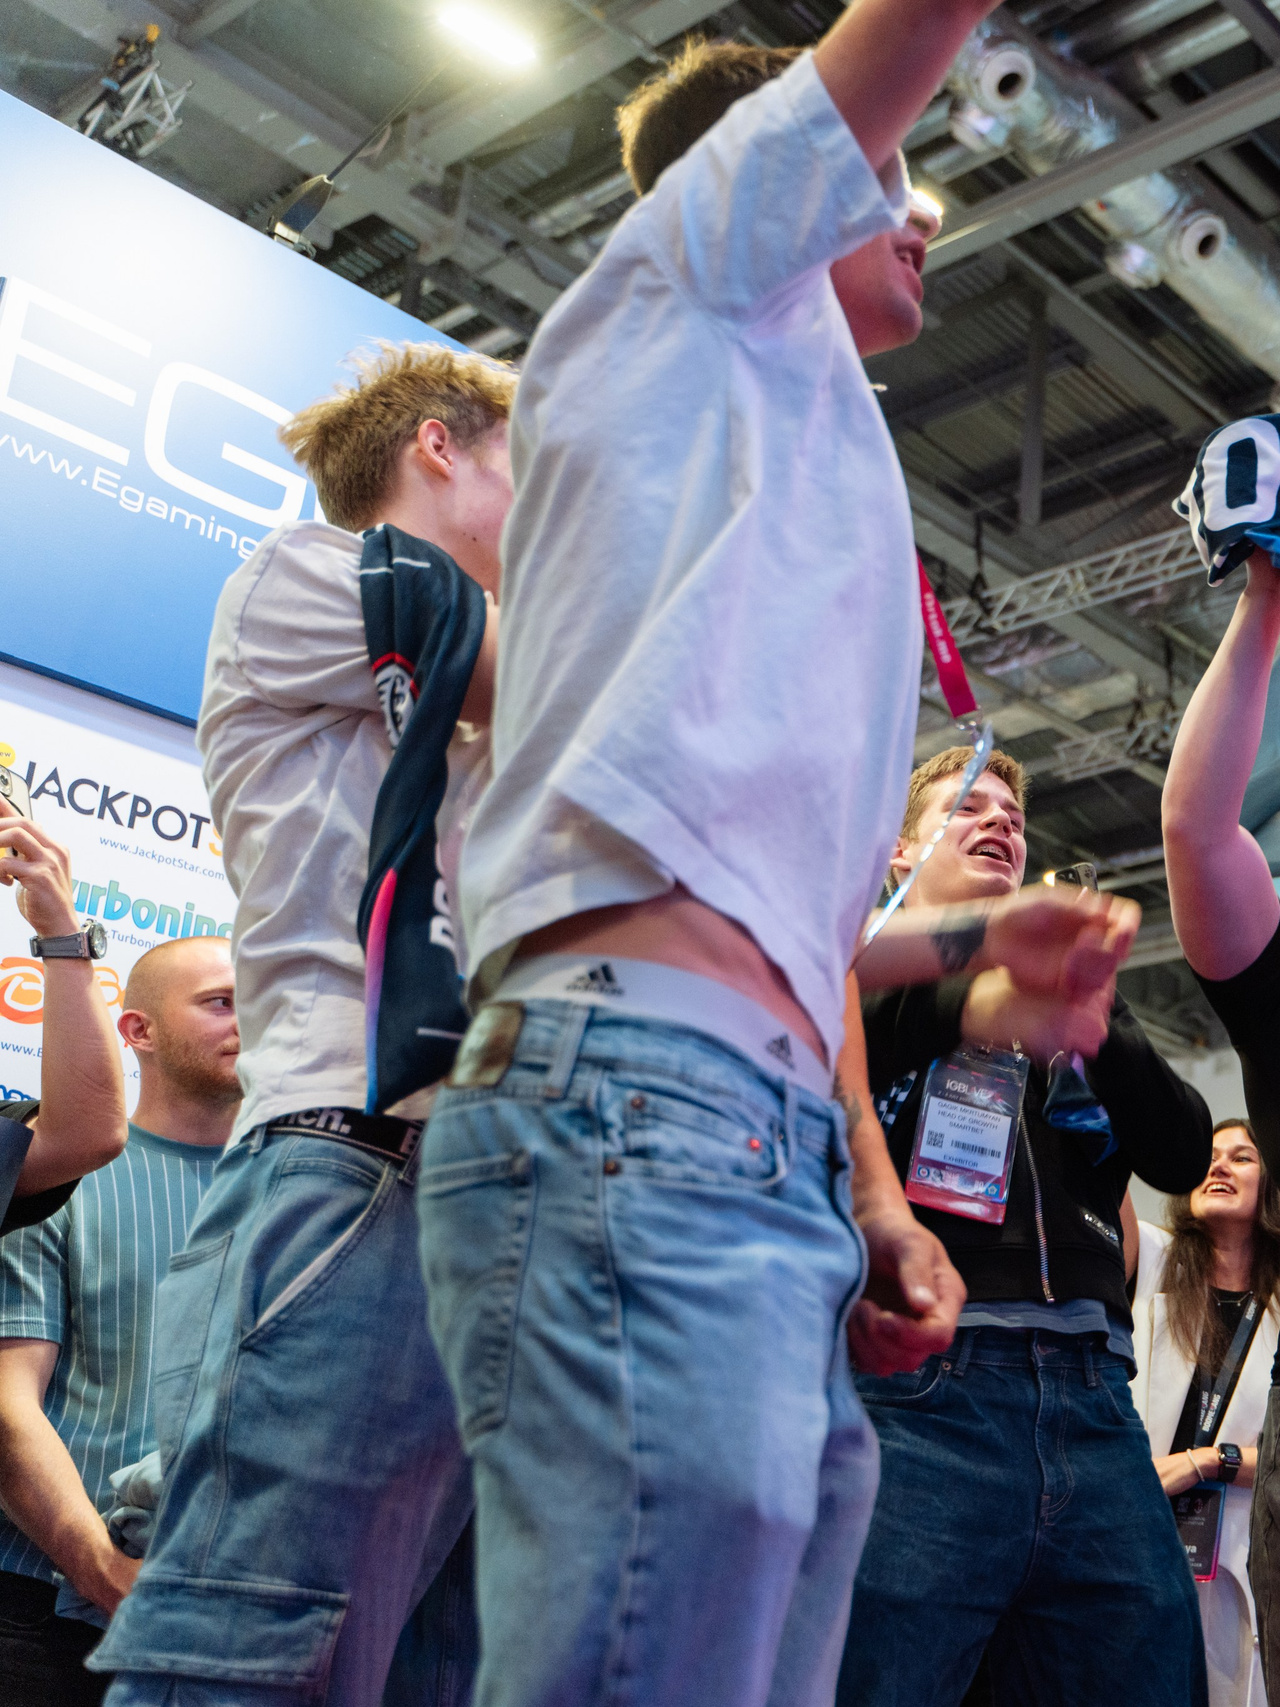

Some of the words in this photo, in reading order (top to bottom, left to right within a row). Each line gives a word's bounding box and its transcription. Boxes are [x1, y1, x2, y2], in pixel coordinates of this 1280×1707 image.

[0, 276, 327, 529] EG
[0, 434, 260, 561] ww.Egaming
[99, 836, 226, 881] www.JackpotStar.com
[942, 1153, 978, 1168] EXHIBITOR
